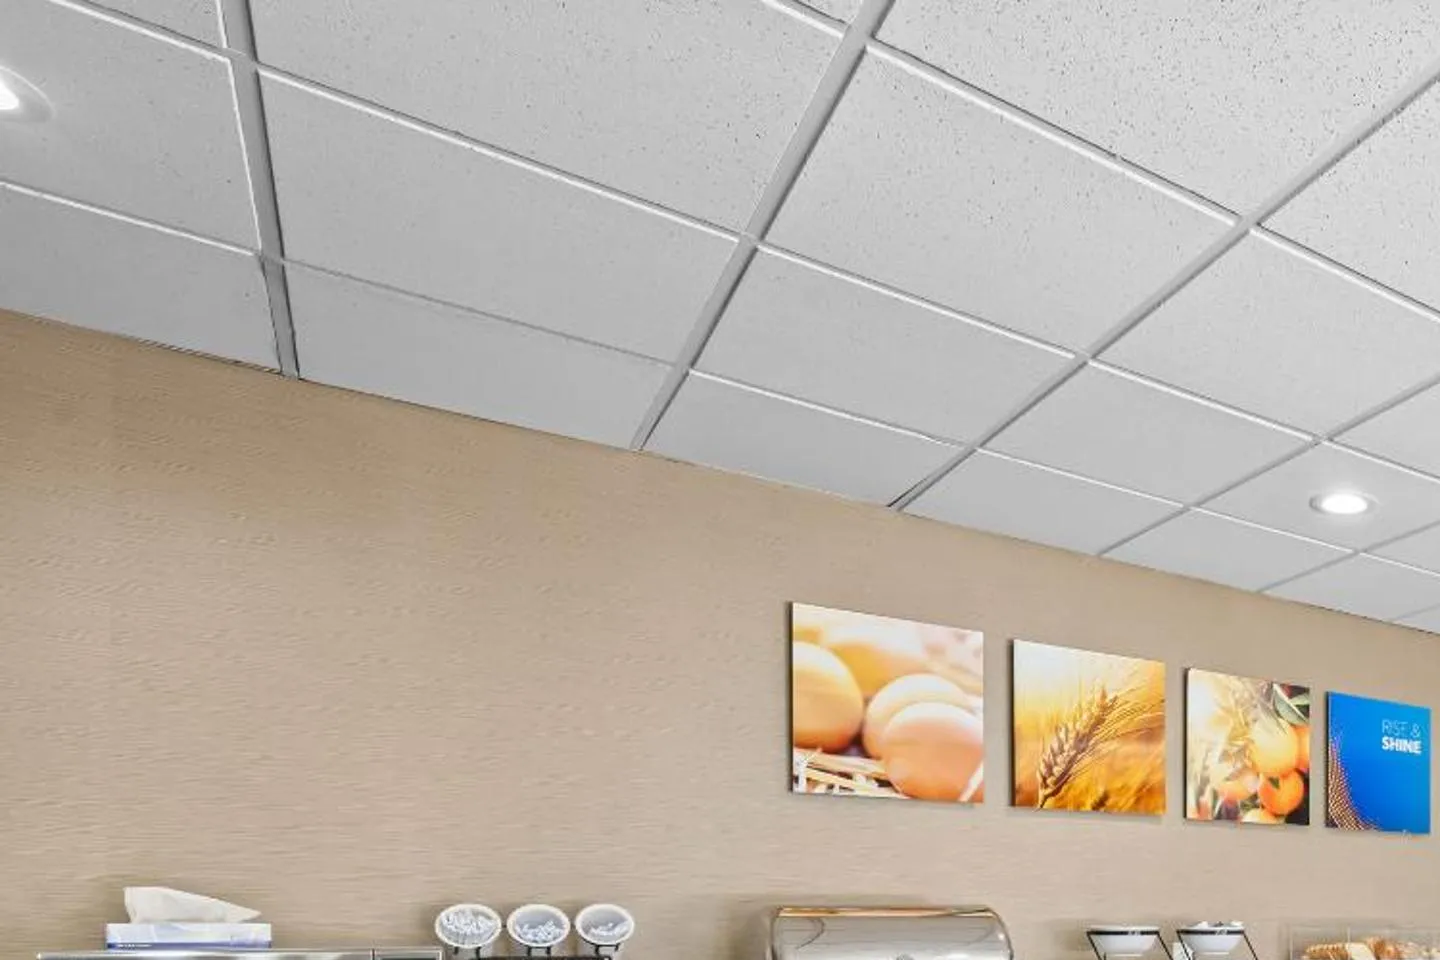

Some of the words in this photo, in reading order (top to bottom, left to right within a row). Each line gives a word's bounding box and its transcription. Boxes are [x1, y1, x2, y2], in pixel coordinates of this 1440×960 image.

[1382, 719, 1408, 738] RISE
[1411, 723, 1420, 738] &
[1382, 736, 1422, 754] SHINE
